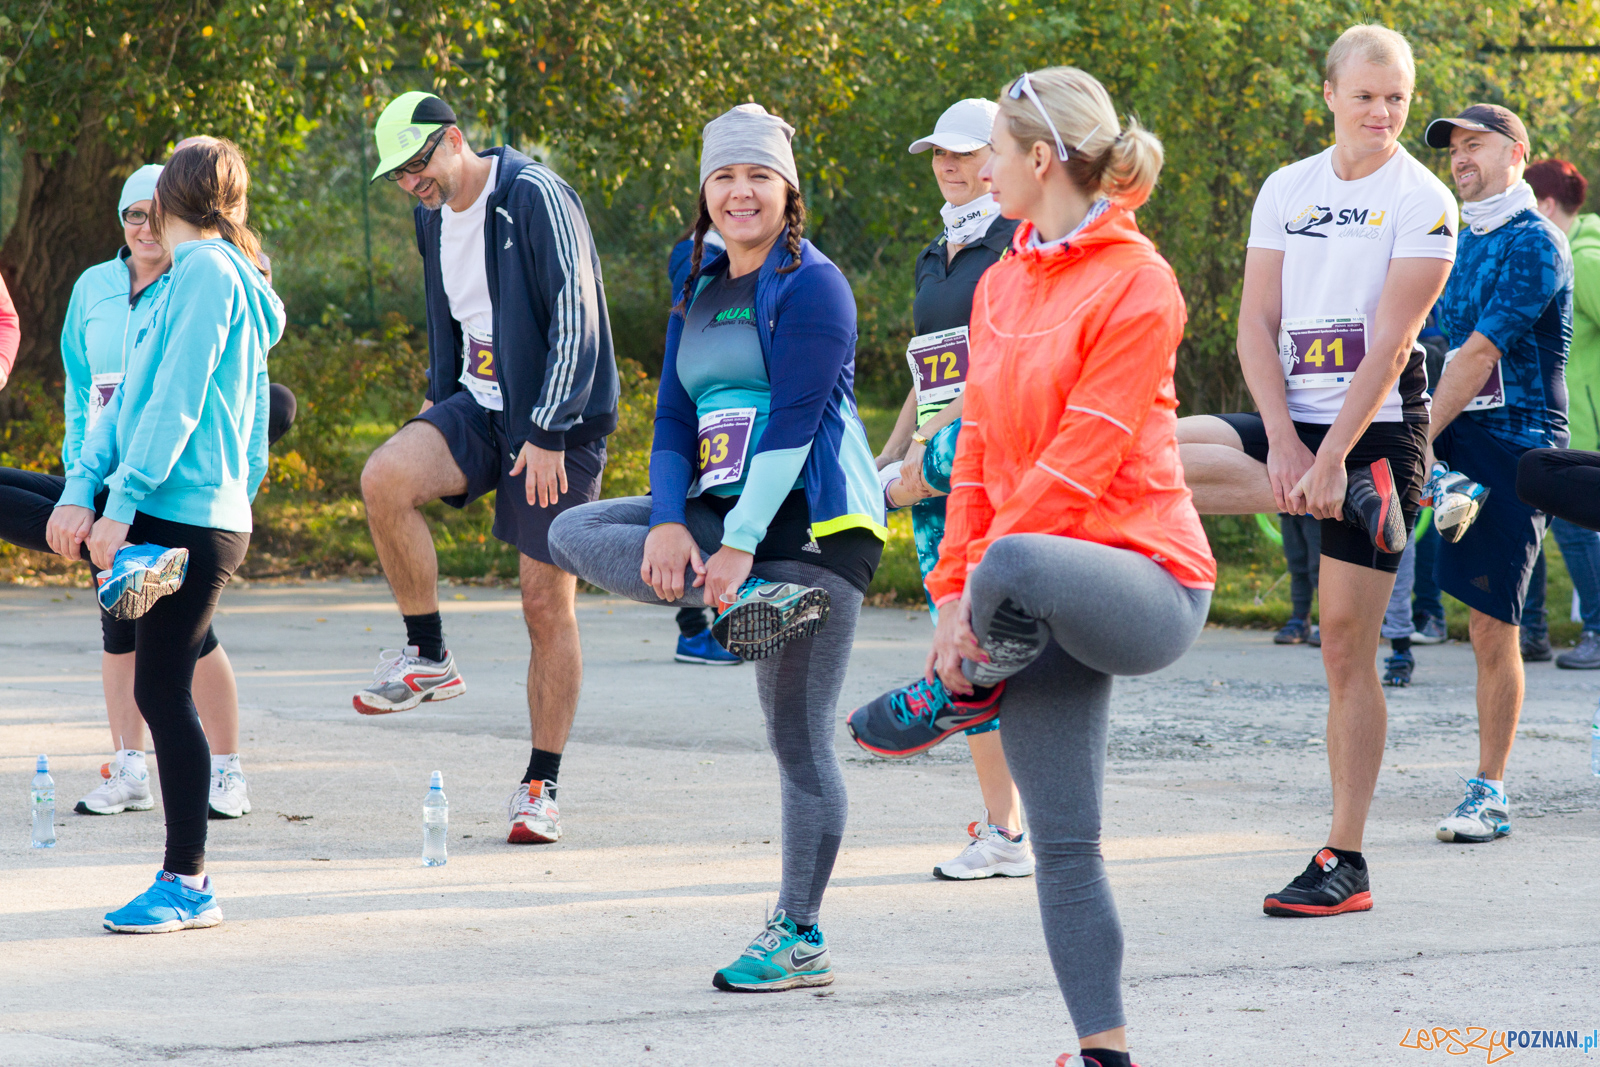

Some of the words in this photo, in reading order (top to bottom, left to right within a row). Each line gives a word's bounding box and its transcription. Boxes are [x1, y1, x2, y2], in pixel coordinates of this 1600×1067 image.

[477, 350, 493, 376] 2
[923, 351, 960, 383] 72
[1304, 337, 1344, 367] 41
[700, 433, 729, 470] 93
